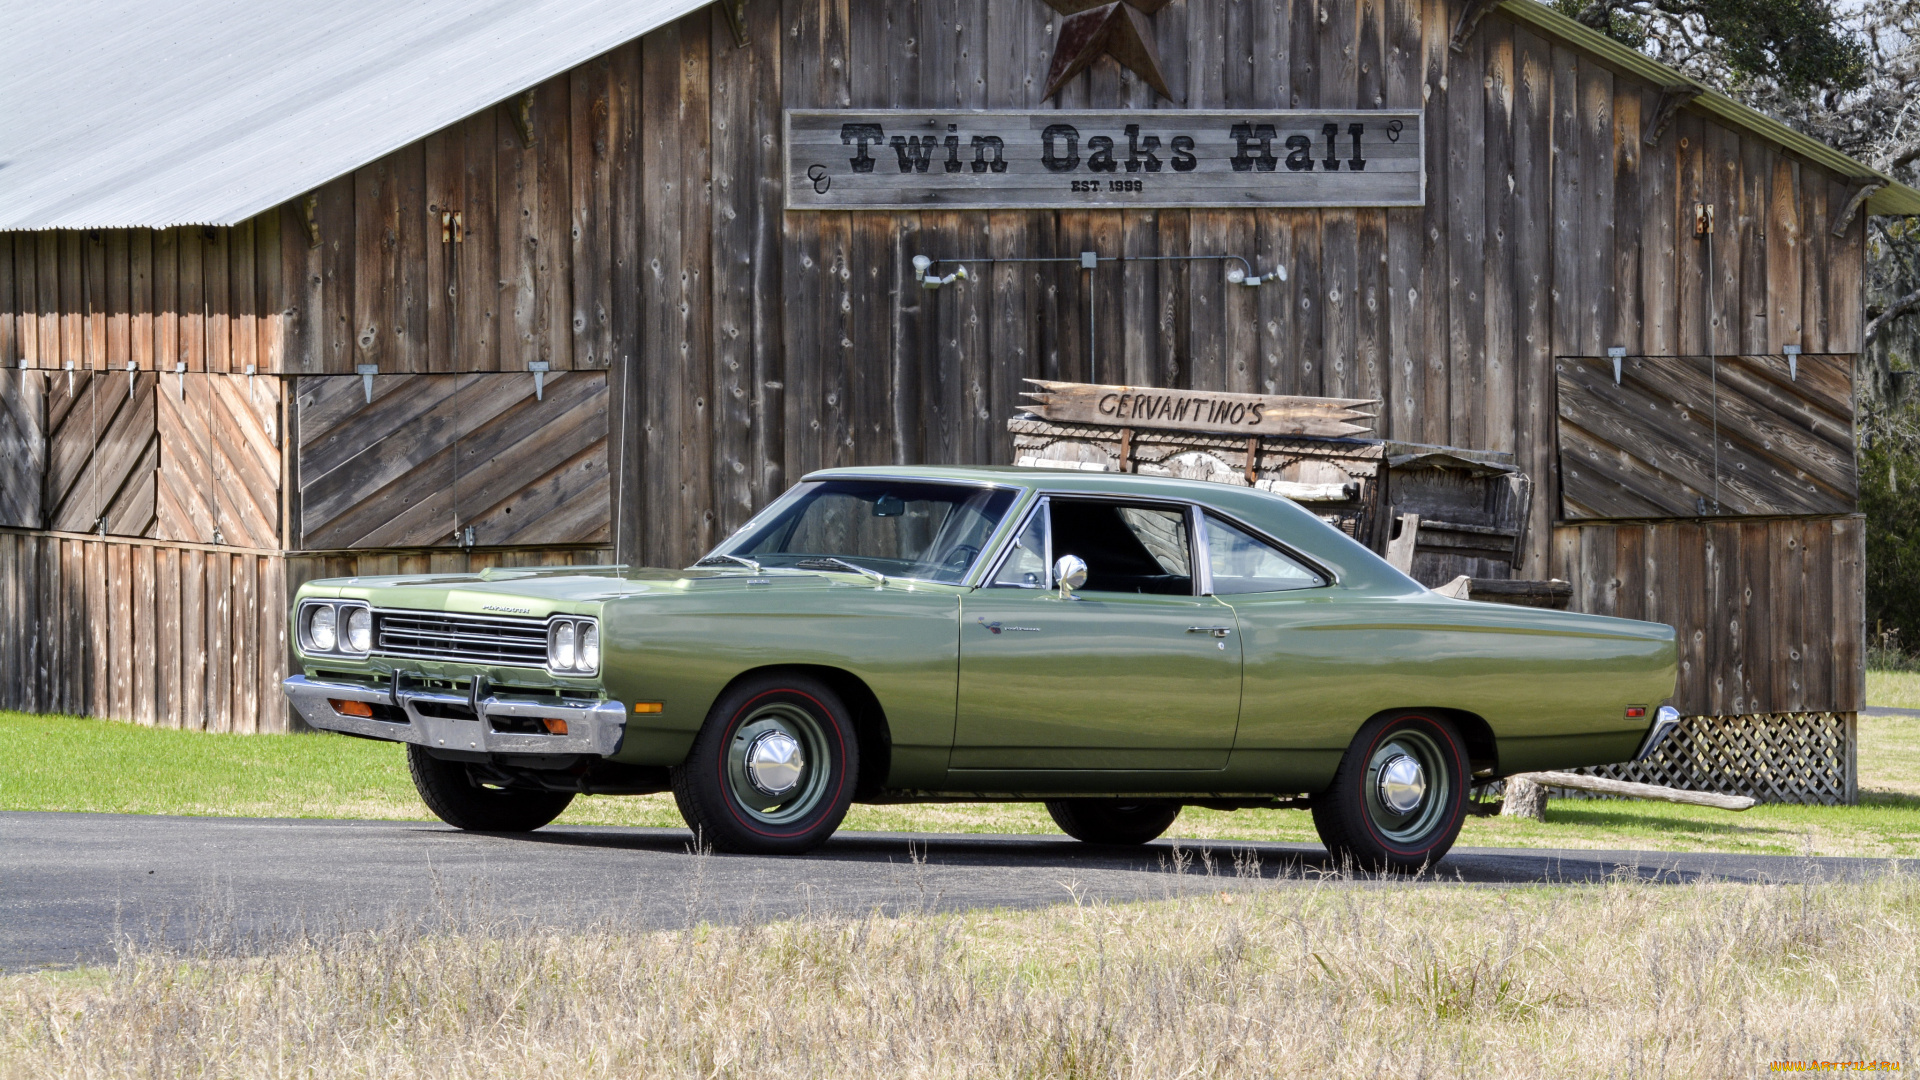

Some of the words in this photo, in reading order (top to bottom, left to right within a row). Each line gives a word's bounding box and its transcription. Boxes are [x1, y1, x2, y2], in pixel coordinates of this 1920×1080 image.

[840, 123, 1008, 173] Twin
[1040, 123, 1197, 173] Oaks
[1229, 122, 1366, 172] Hall
[1070, 180, 1103, 192] EST.
[1098, 392, 1266, 426] CERVANTINO'S
